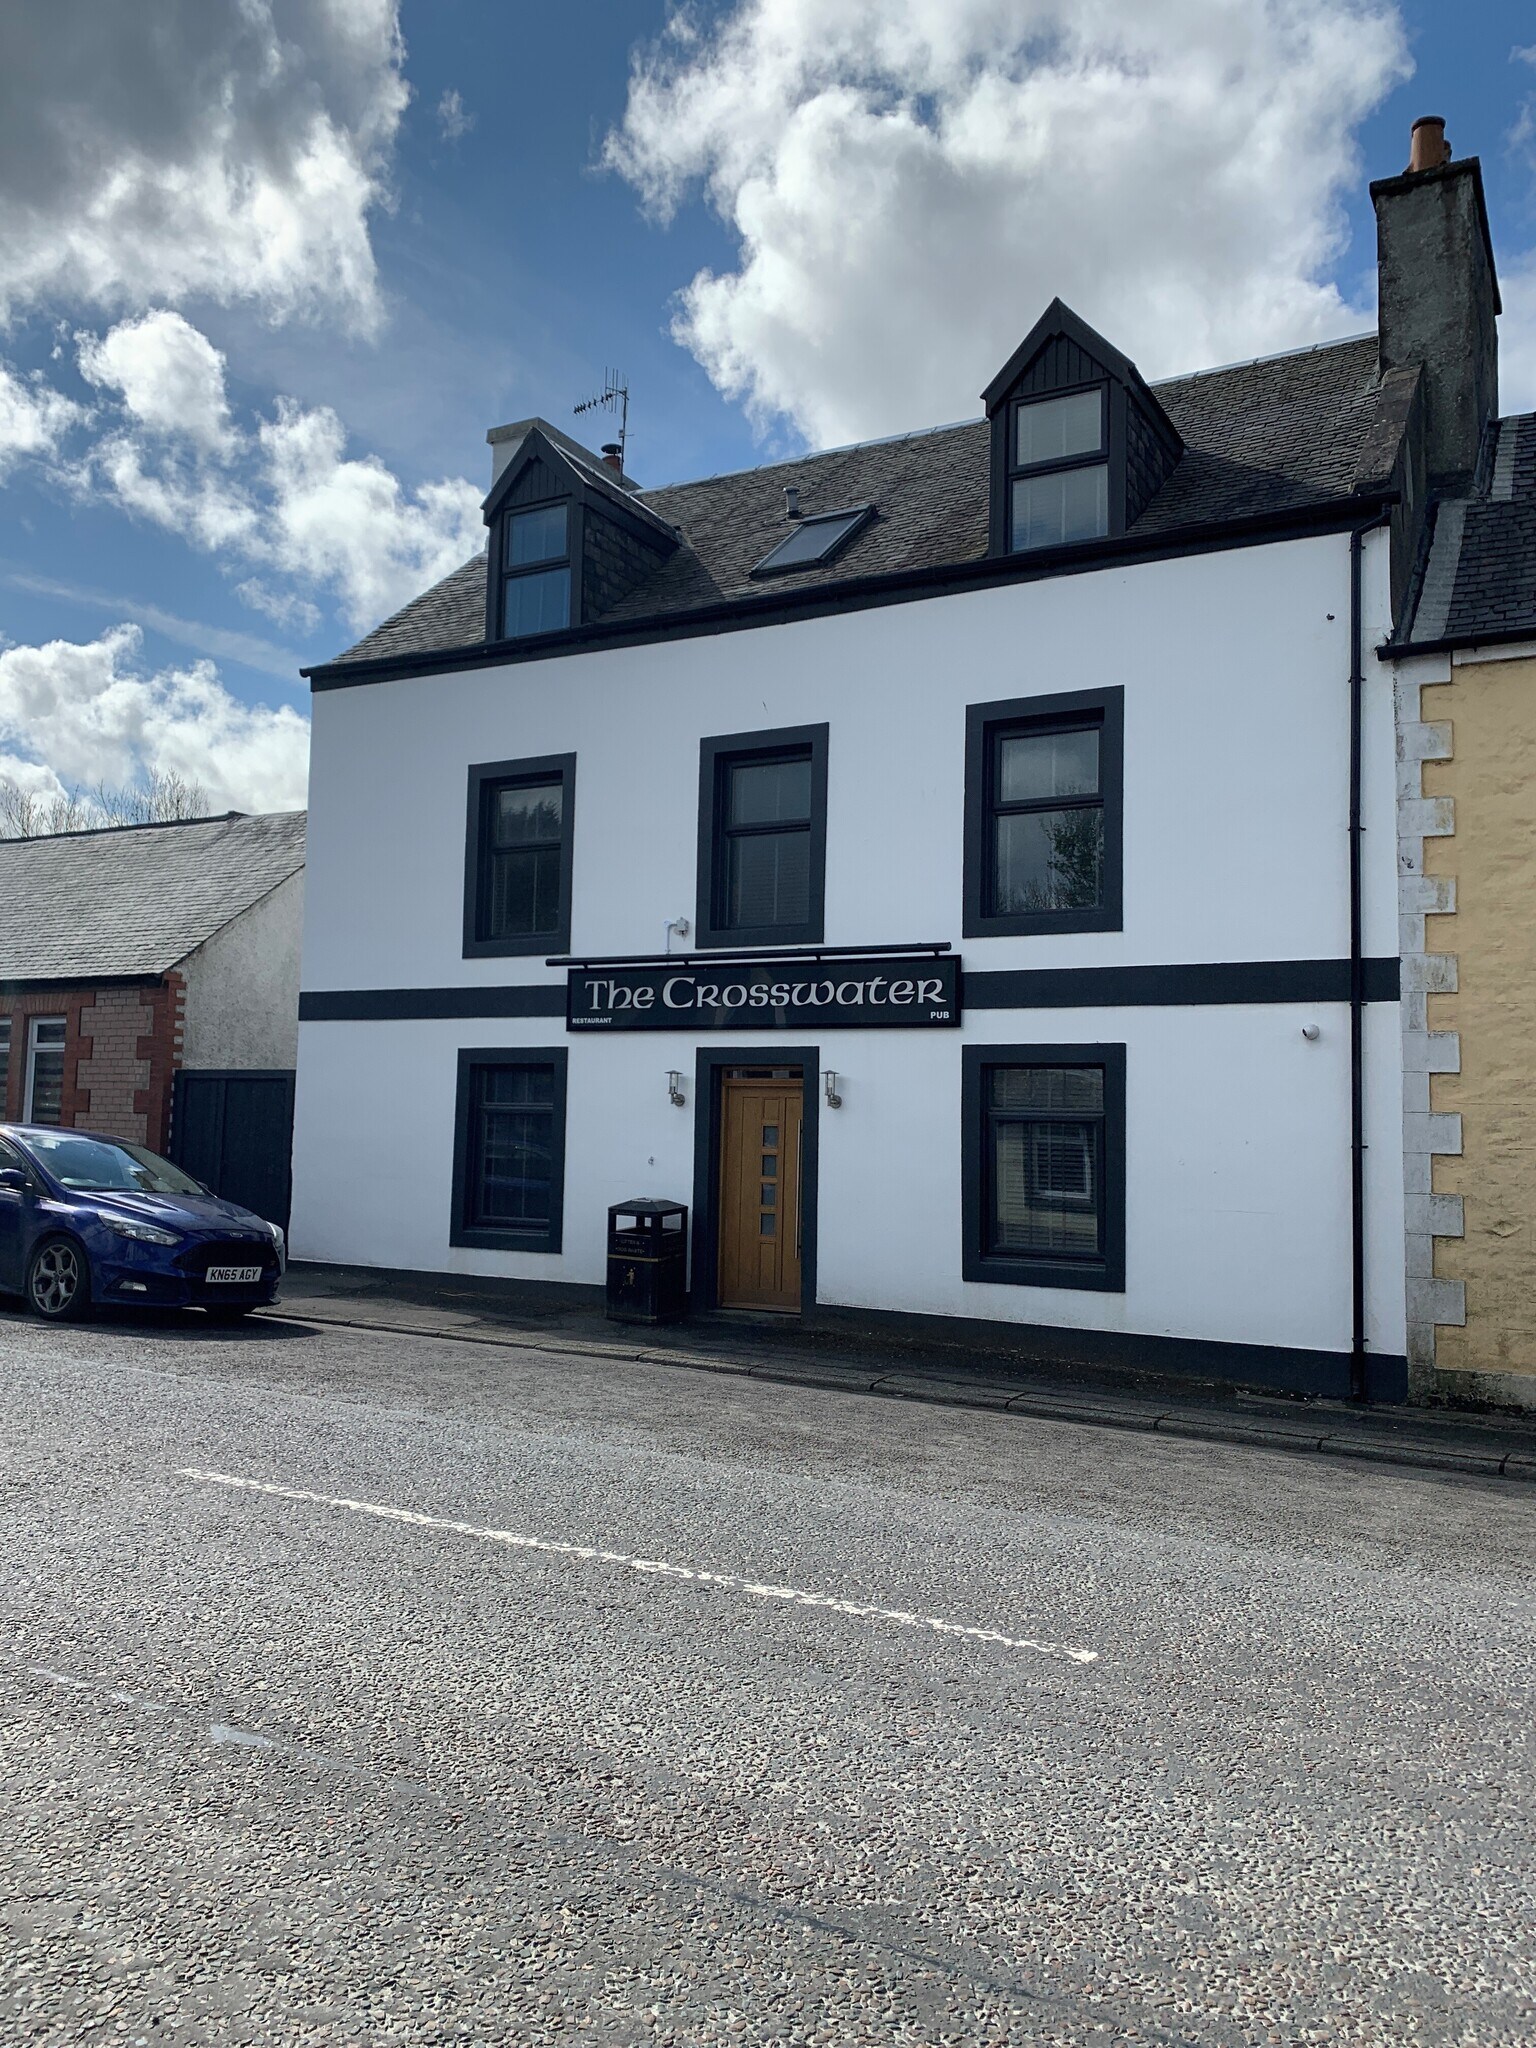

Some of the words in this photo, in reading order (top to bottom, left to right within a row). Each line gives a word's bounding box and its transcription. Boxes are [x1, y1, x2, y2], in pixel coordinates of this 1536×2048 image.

[585, 980, 655, 1010] The
[930, 1011, 950, 1019] PUB
[210, 1269, 237, 1281] KN65
[238, 1269, 258, 1280] AGY
